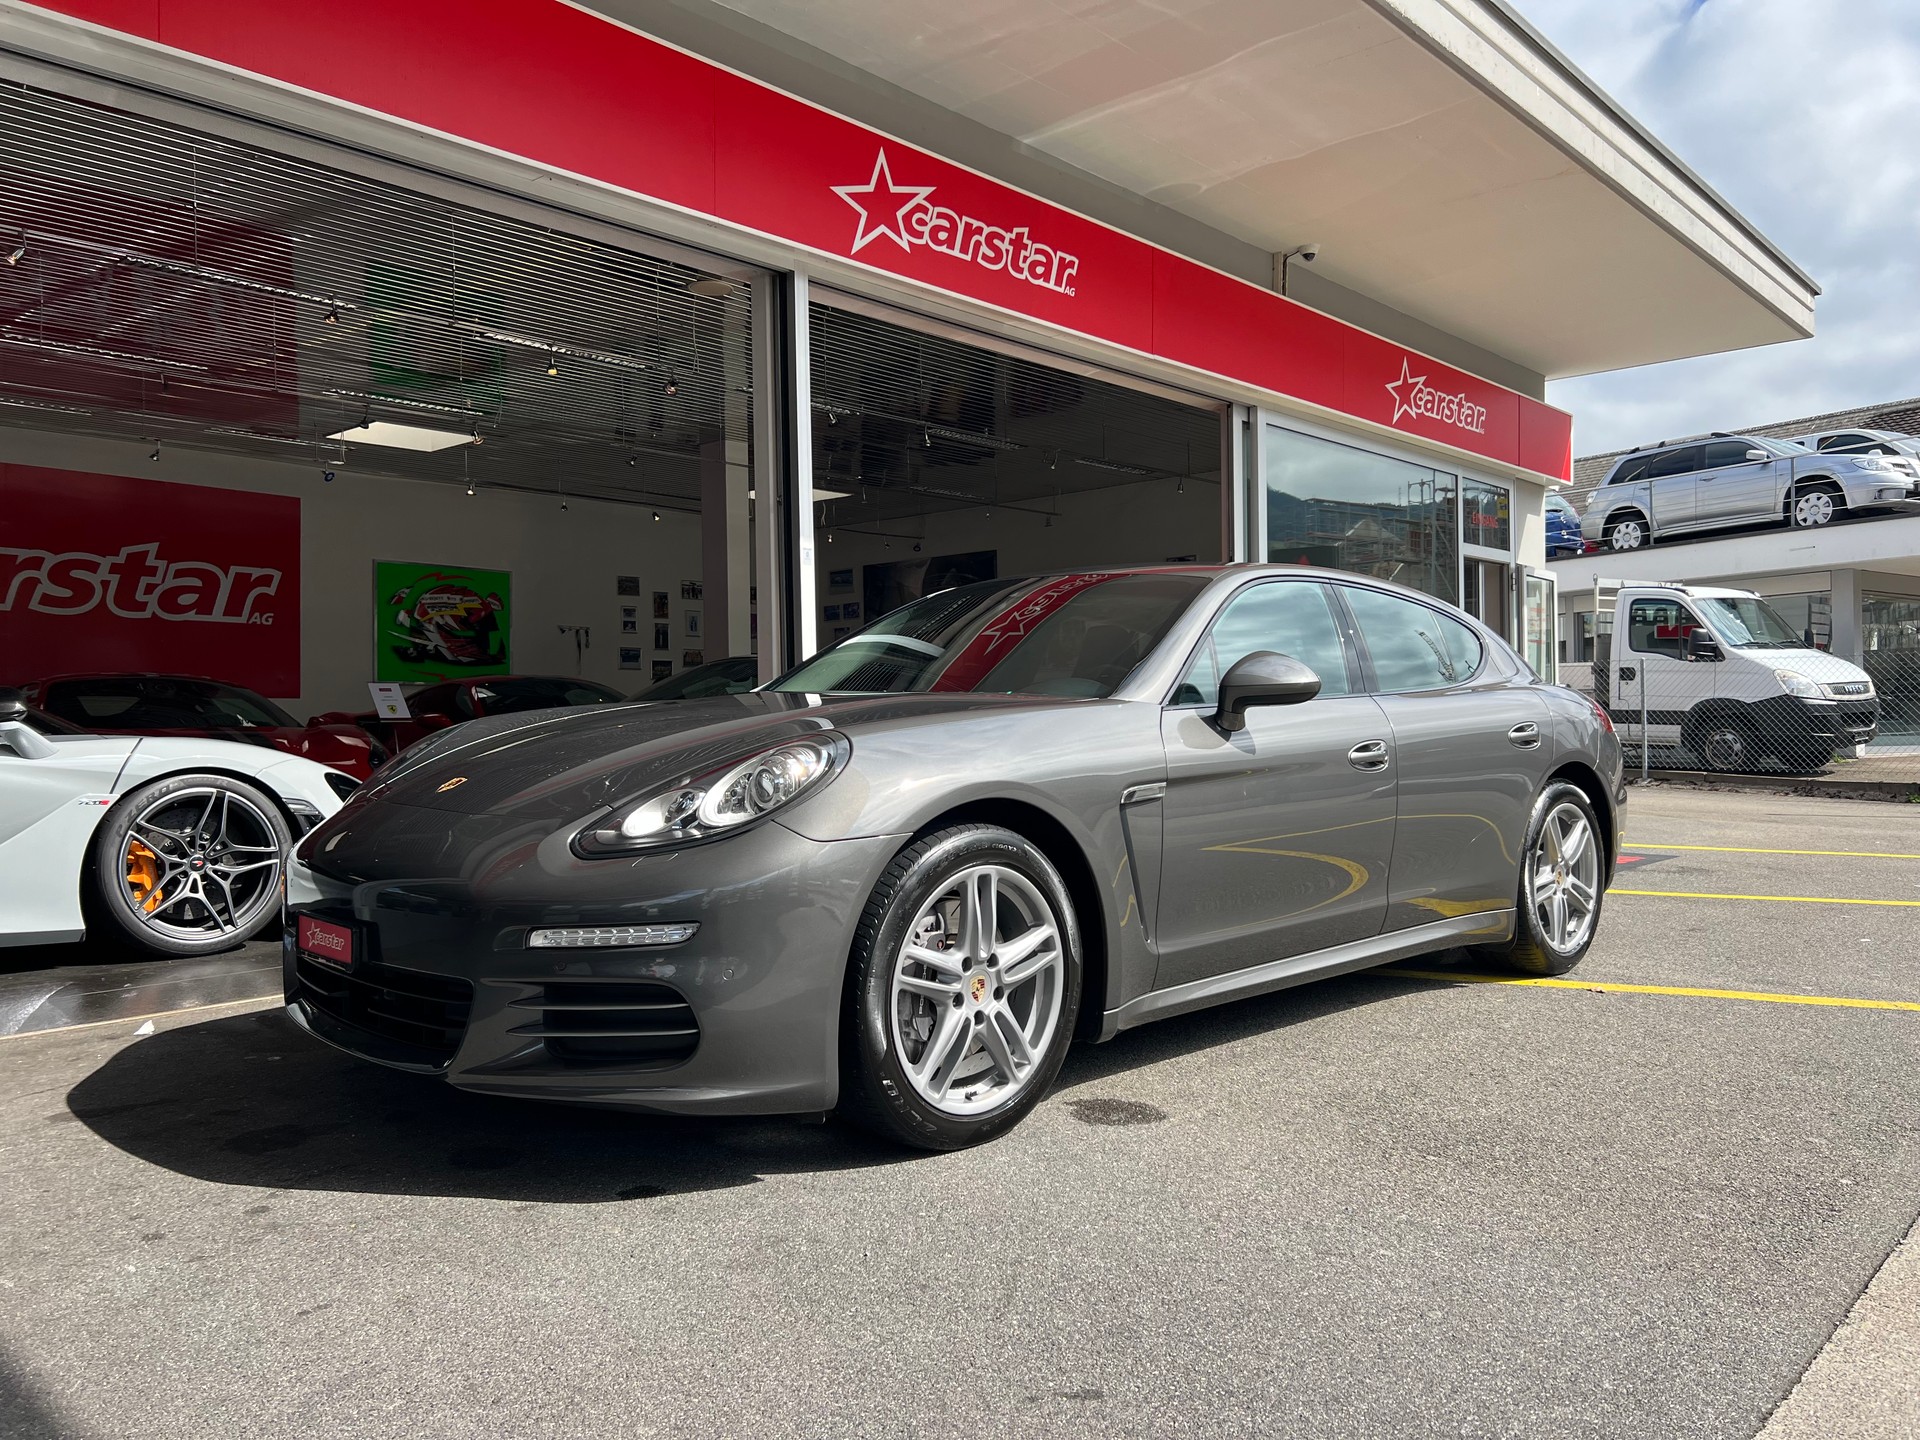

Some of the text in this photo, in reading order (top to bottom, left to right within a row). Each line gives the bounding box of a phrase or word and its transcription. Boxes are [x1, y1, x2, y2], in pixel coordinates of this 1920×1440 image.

[900, 199, 1079, 297] carstar AG
[1411, 386, 1486, 433] carstar
[250, 612, 274, 625] AG
[1844, 684, 1864, 693] IVECO
[314, 931, 345, 951] carstar
